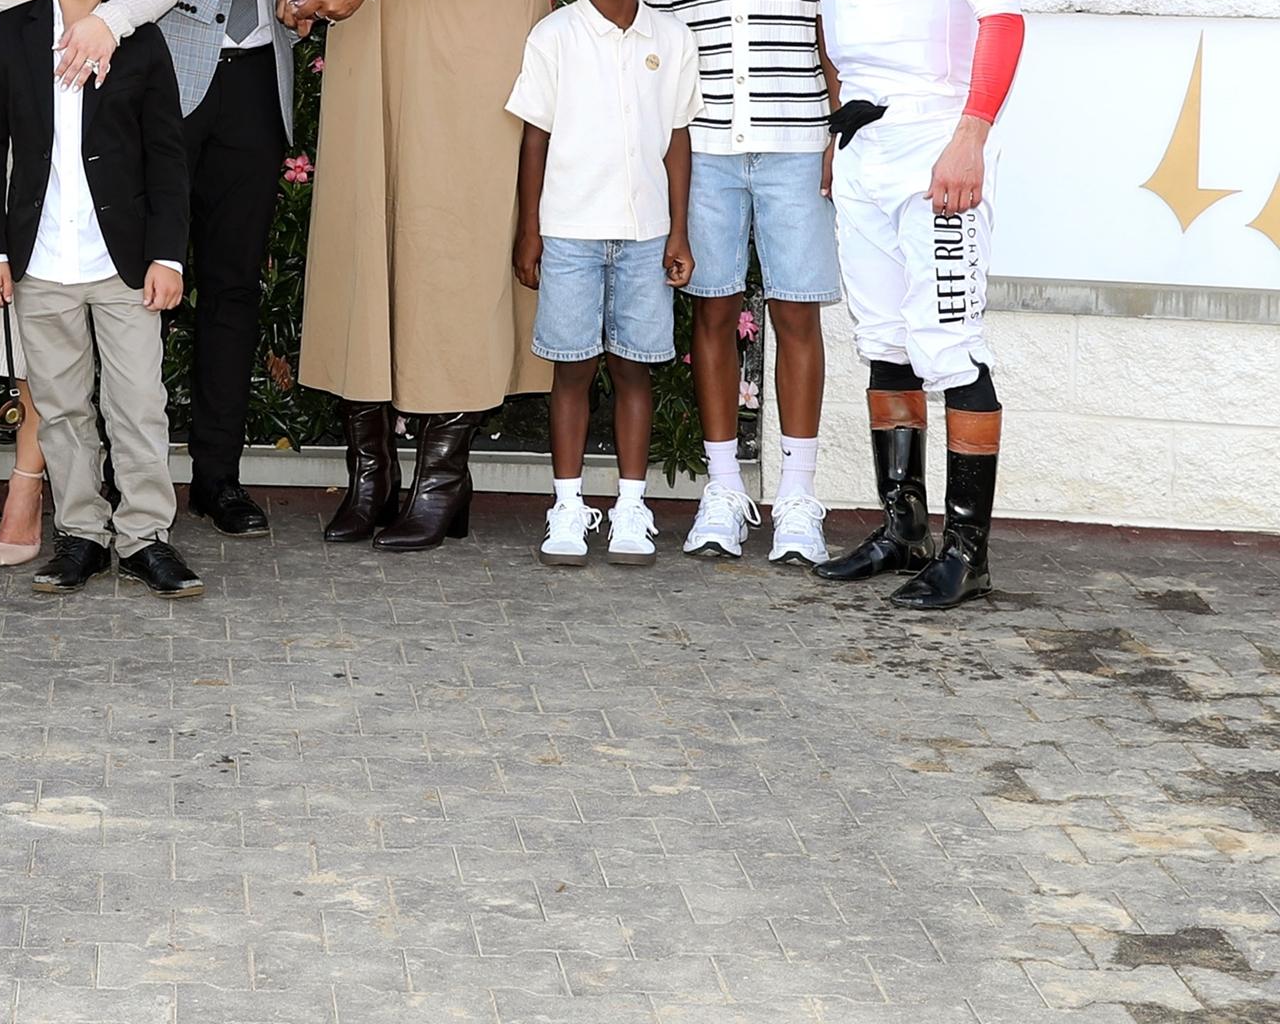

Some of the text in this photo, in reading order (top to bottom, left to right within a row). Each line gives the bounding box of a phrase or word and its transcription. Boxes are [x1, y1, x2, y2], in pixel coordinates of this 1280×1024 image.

[933, 214, 967, 325] JEFF RUB
[967, 213, 980, 320] STEAKHOU
